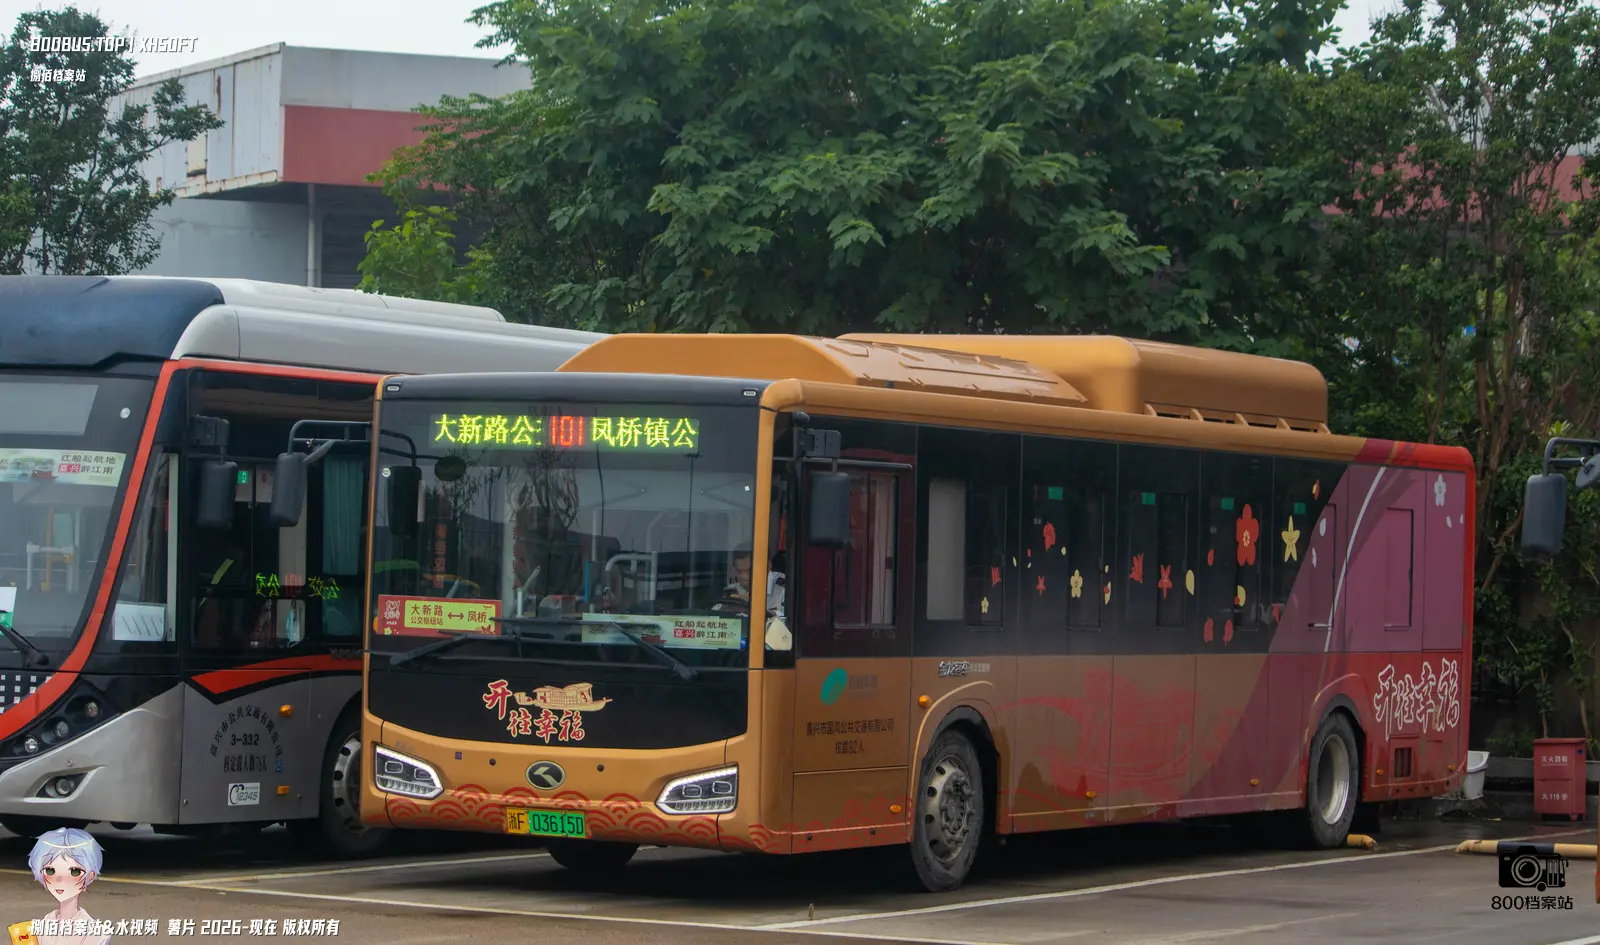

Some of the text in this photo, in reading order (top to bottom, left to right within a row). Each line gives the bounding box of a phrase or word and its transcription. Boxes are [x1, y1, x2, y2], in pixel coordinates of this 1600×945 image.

[434, 413, 699, 449] 大新路公 101 凤桥镇公
[61, 454, 117, 465] 红船起航地
[410, 604, 444, 617] 大新路
[467, 611, 488, 623] 凤桥
[674, 620, 728, 630] 红船起航地
[483, 679, 513, 721] 开
[1374, 657, 1460, 742] 开往幸福
[506, 707, 586, 744] 往幸福
[230, 733, 260, 746] 3-332
[235, 791, 258, 801] 12345
[531, 813, 585, 835] 03615D
